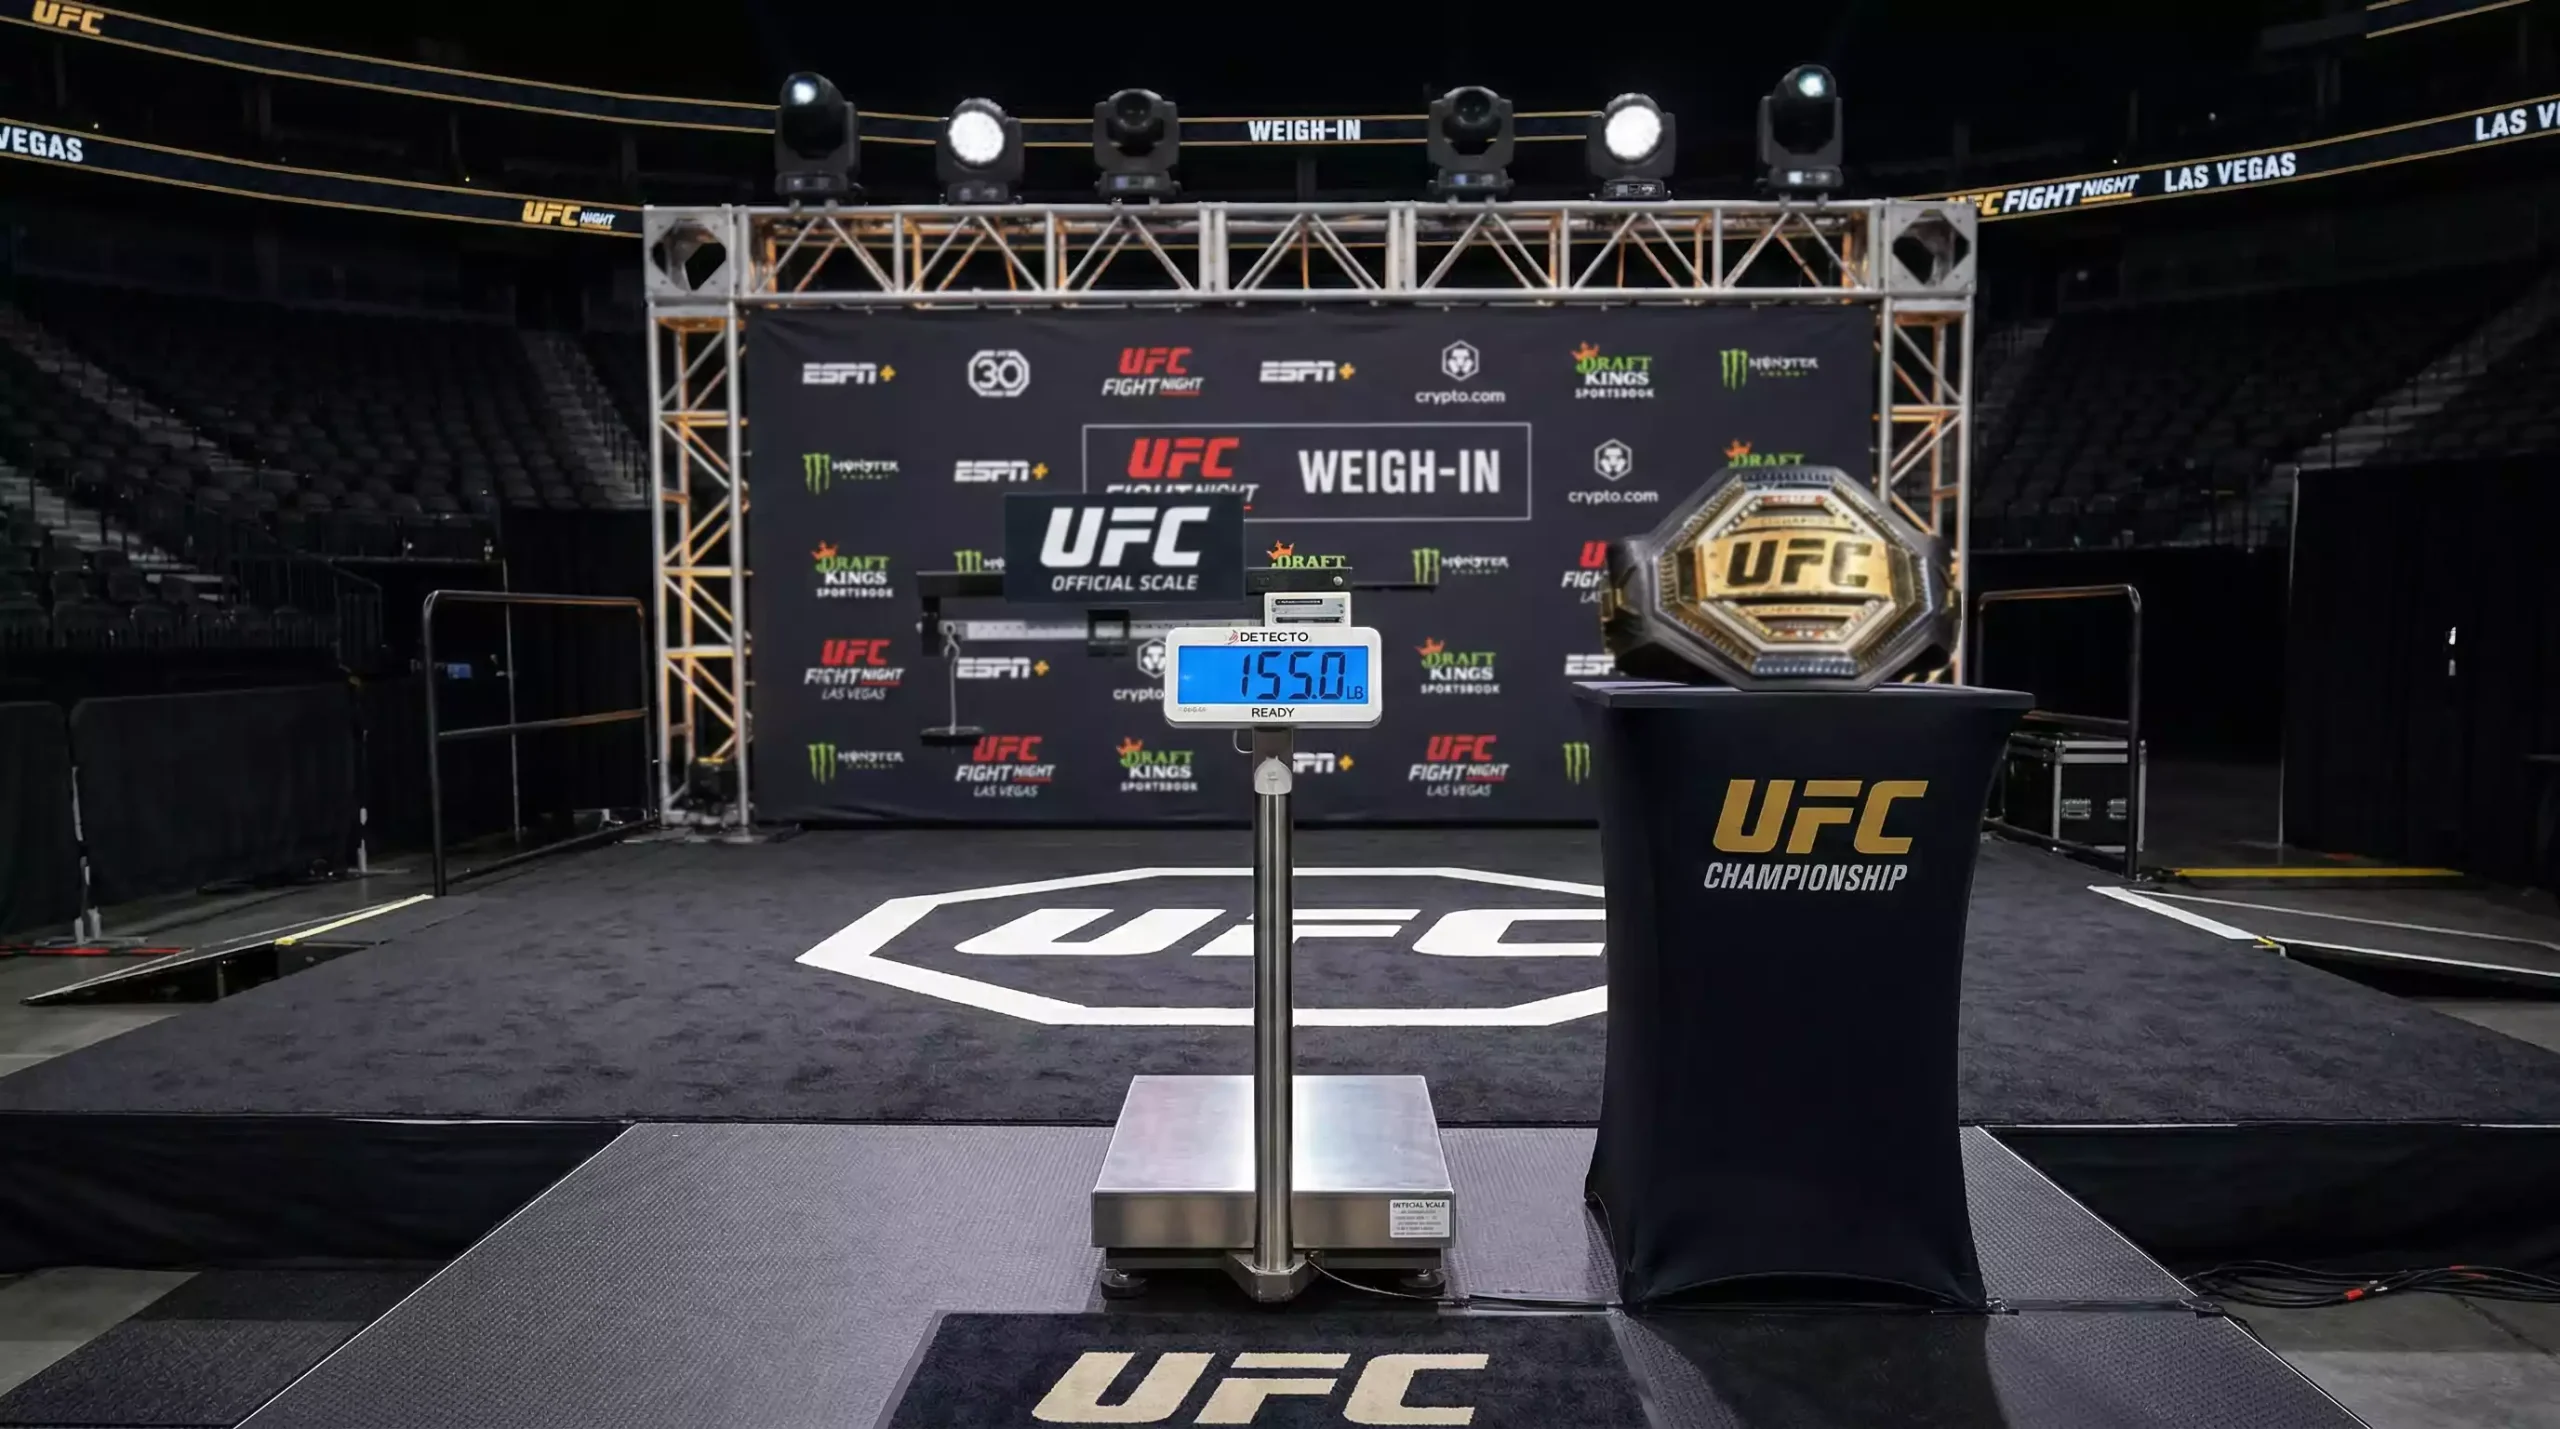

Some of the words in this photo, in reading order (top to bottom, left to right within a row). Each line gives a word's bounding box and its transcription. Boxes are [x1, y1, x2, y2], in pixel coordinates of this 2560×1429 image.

[32, 0, 104, 34] UFC
[1248, 119, 1361, 141] WEIGH-IN
[2475, 108, 2527, 141] LAS
[2164, 164, 2209, 192] LAS
[2216, 152, 2296, 185] VEGAS
[2002, 181, 2082, 213] FIGHT
[2082, 174, 2140, 196] NIGHT
[522, 200, 581, 226] UFC
[580, 211, 615, 225] NIGHT
[1119, 347, 1192, 375] UFC
[1575, 356, 1652, 374] DRAFT
[977, 358, 1022, 389] 30
[1584, 370, 1650, 386] KINGS
[1101, 378, 1160, 396] FIGHT
[1160, 377, 1204, 391] NIGHT
[1575, 388, 1654, 399] SPORTSBOOK
[1415, 389, 1506, 405] crypto.com
[1127, 438, 1239, 478] UFC
[1728, 454, 1804, 468] DRAFT
[1298, 450, 1499, 493] WEIGH-IN
[1568, 489, 1659, 504] crypto.com
[1040, 506, 1211, 567] UFC
[815, 556, 890, 573] DRAFT
[1271, 555, 1346, 569] DRAFT
[1727, 537, 1872, 588] UFC
[825, 570, 887, 585] KINGS
[1051, 575, 1134, 591] OFFICIAL
[1139, 574, 1198, 590] SCALE
[816, 587, 894, 598] SPORTSBOOK
[1240, 631, 1309, 643] DETECTO
[821, 639, 892, 666] UFC
[1421, 652, 1496, 668] DRAFT
[803, 668, 861, 685] FIGHT
[861, 668, 905, 680] NIGHT
[1241, 652, 1346, 700] 155.0
[1347, 686, 1363, 700] LB
[1429, 666, 1494, 681] KINGS
[821, 687, 845, 700] LAS
[846, 687, 887, 700] VEGAS
[1113, 687, 1165, 702] crypto
[1420, 684, 1500, 694] SPORTSBOOK
[1252, 708, 1295, 718] READY
[973, 736, 1043, 762] UFC
[1426, 735, 1497, 761] UFC
[1120, 750, 1194, 768] DRAFT
[955, 764, 1013, 782] FIGHT
[1012, 764, 1056, 777] NIGHT
[1129, 765, 1192, 779] KINGS
[1408, 763, 1467, 781] FIGHT
[1466, 763, 1510, 776] NIGHT
[973, 785, 997, 797] LAS
[999, 785, 1039, 797] VEGAS
[1121, 782, 1198, 792] SPORTSBOOK
[1426, 784, 1450, 797] LAS
[1452, 784, 1492, 797] VEGAS
[1713, 780, 1929, 854] UFC
[1703, 862, 1908, 891] CHAMPIONSHIP
[954, 908, 1607, 956] UFC
[1031, 1352, 1490, 1425] UFC
